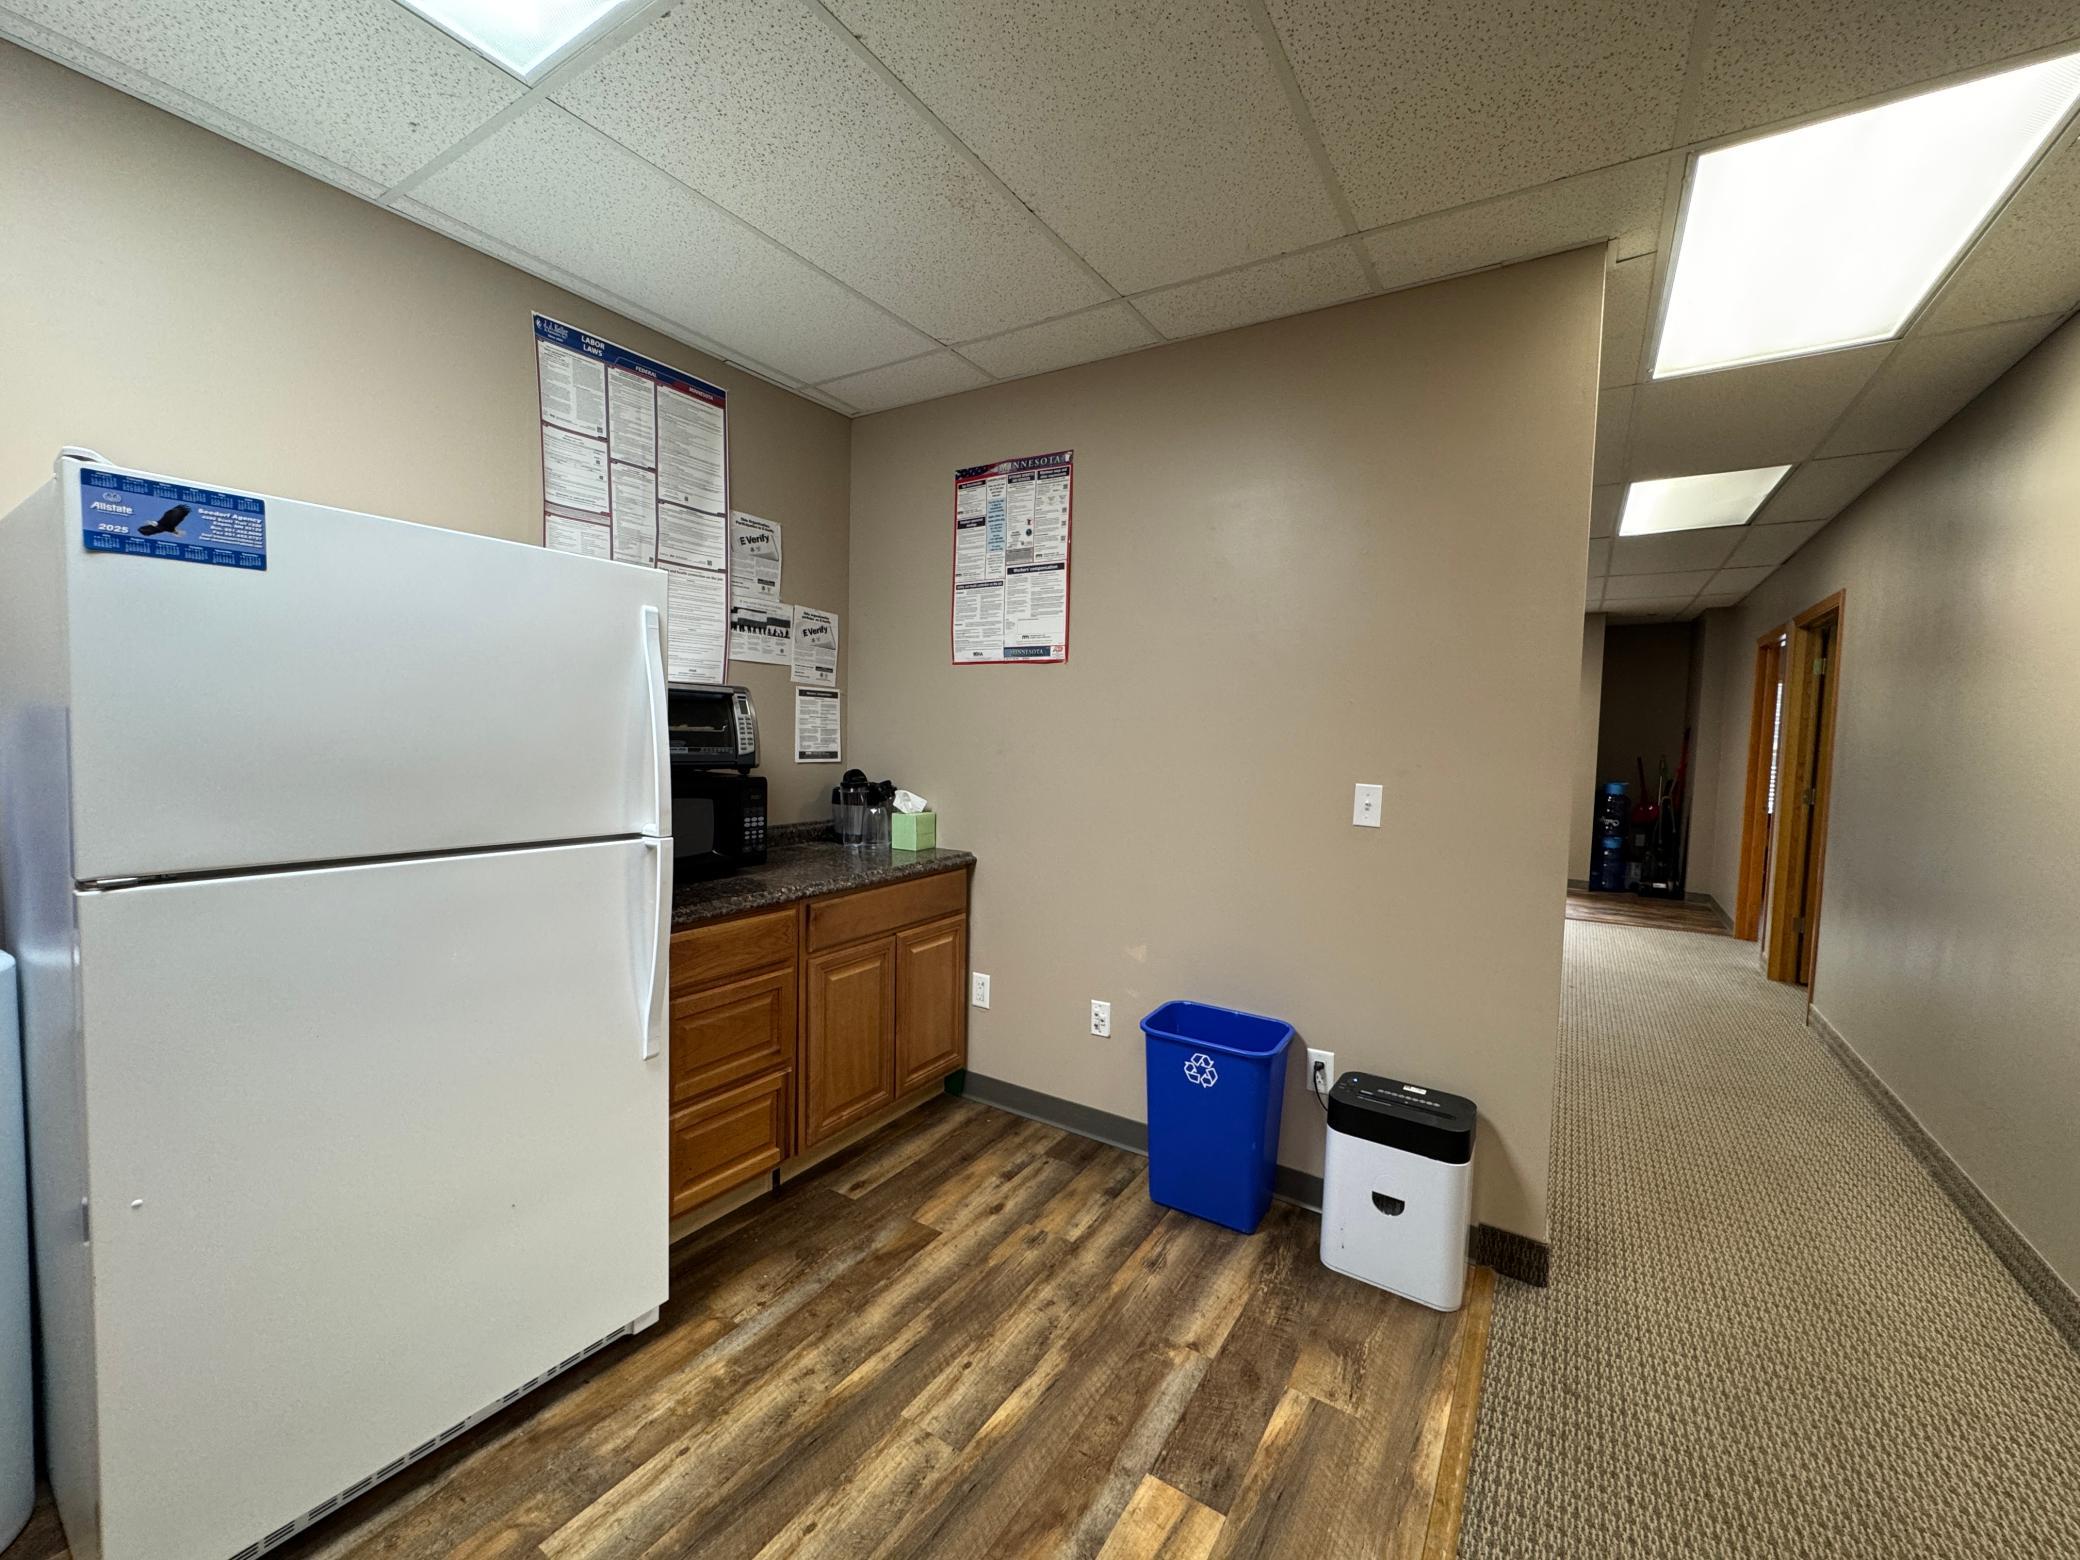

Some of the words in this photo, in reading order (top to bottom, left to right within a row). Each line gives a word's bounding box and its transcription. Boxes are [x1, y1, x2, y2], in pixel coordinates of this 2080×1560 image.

[581, 335, 605, 350] LABOR
[583, 344, 603, 357] LAWS
[635, 365, 657, 378] FEDERAL
[90, 501, 133, 514] Allstate
[98, 523, 129, 534] 2025
